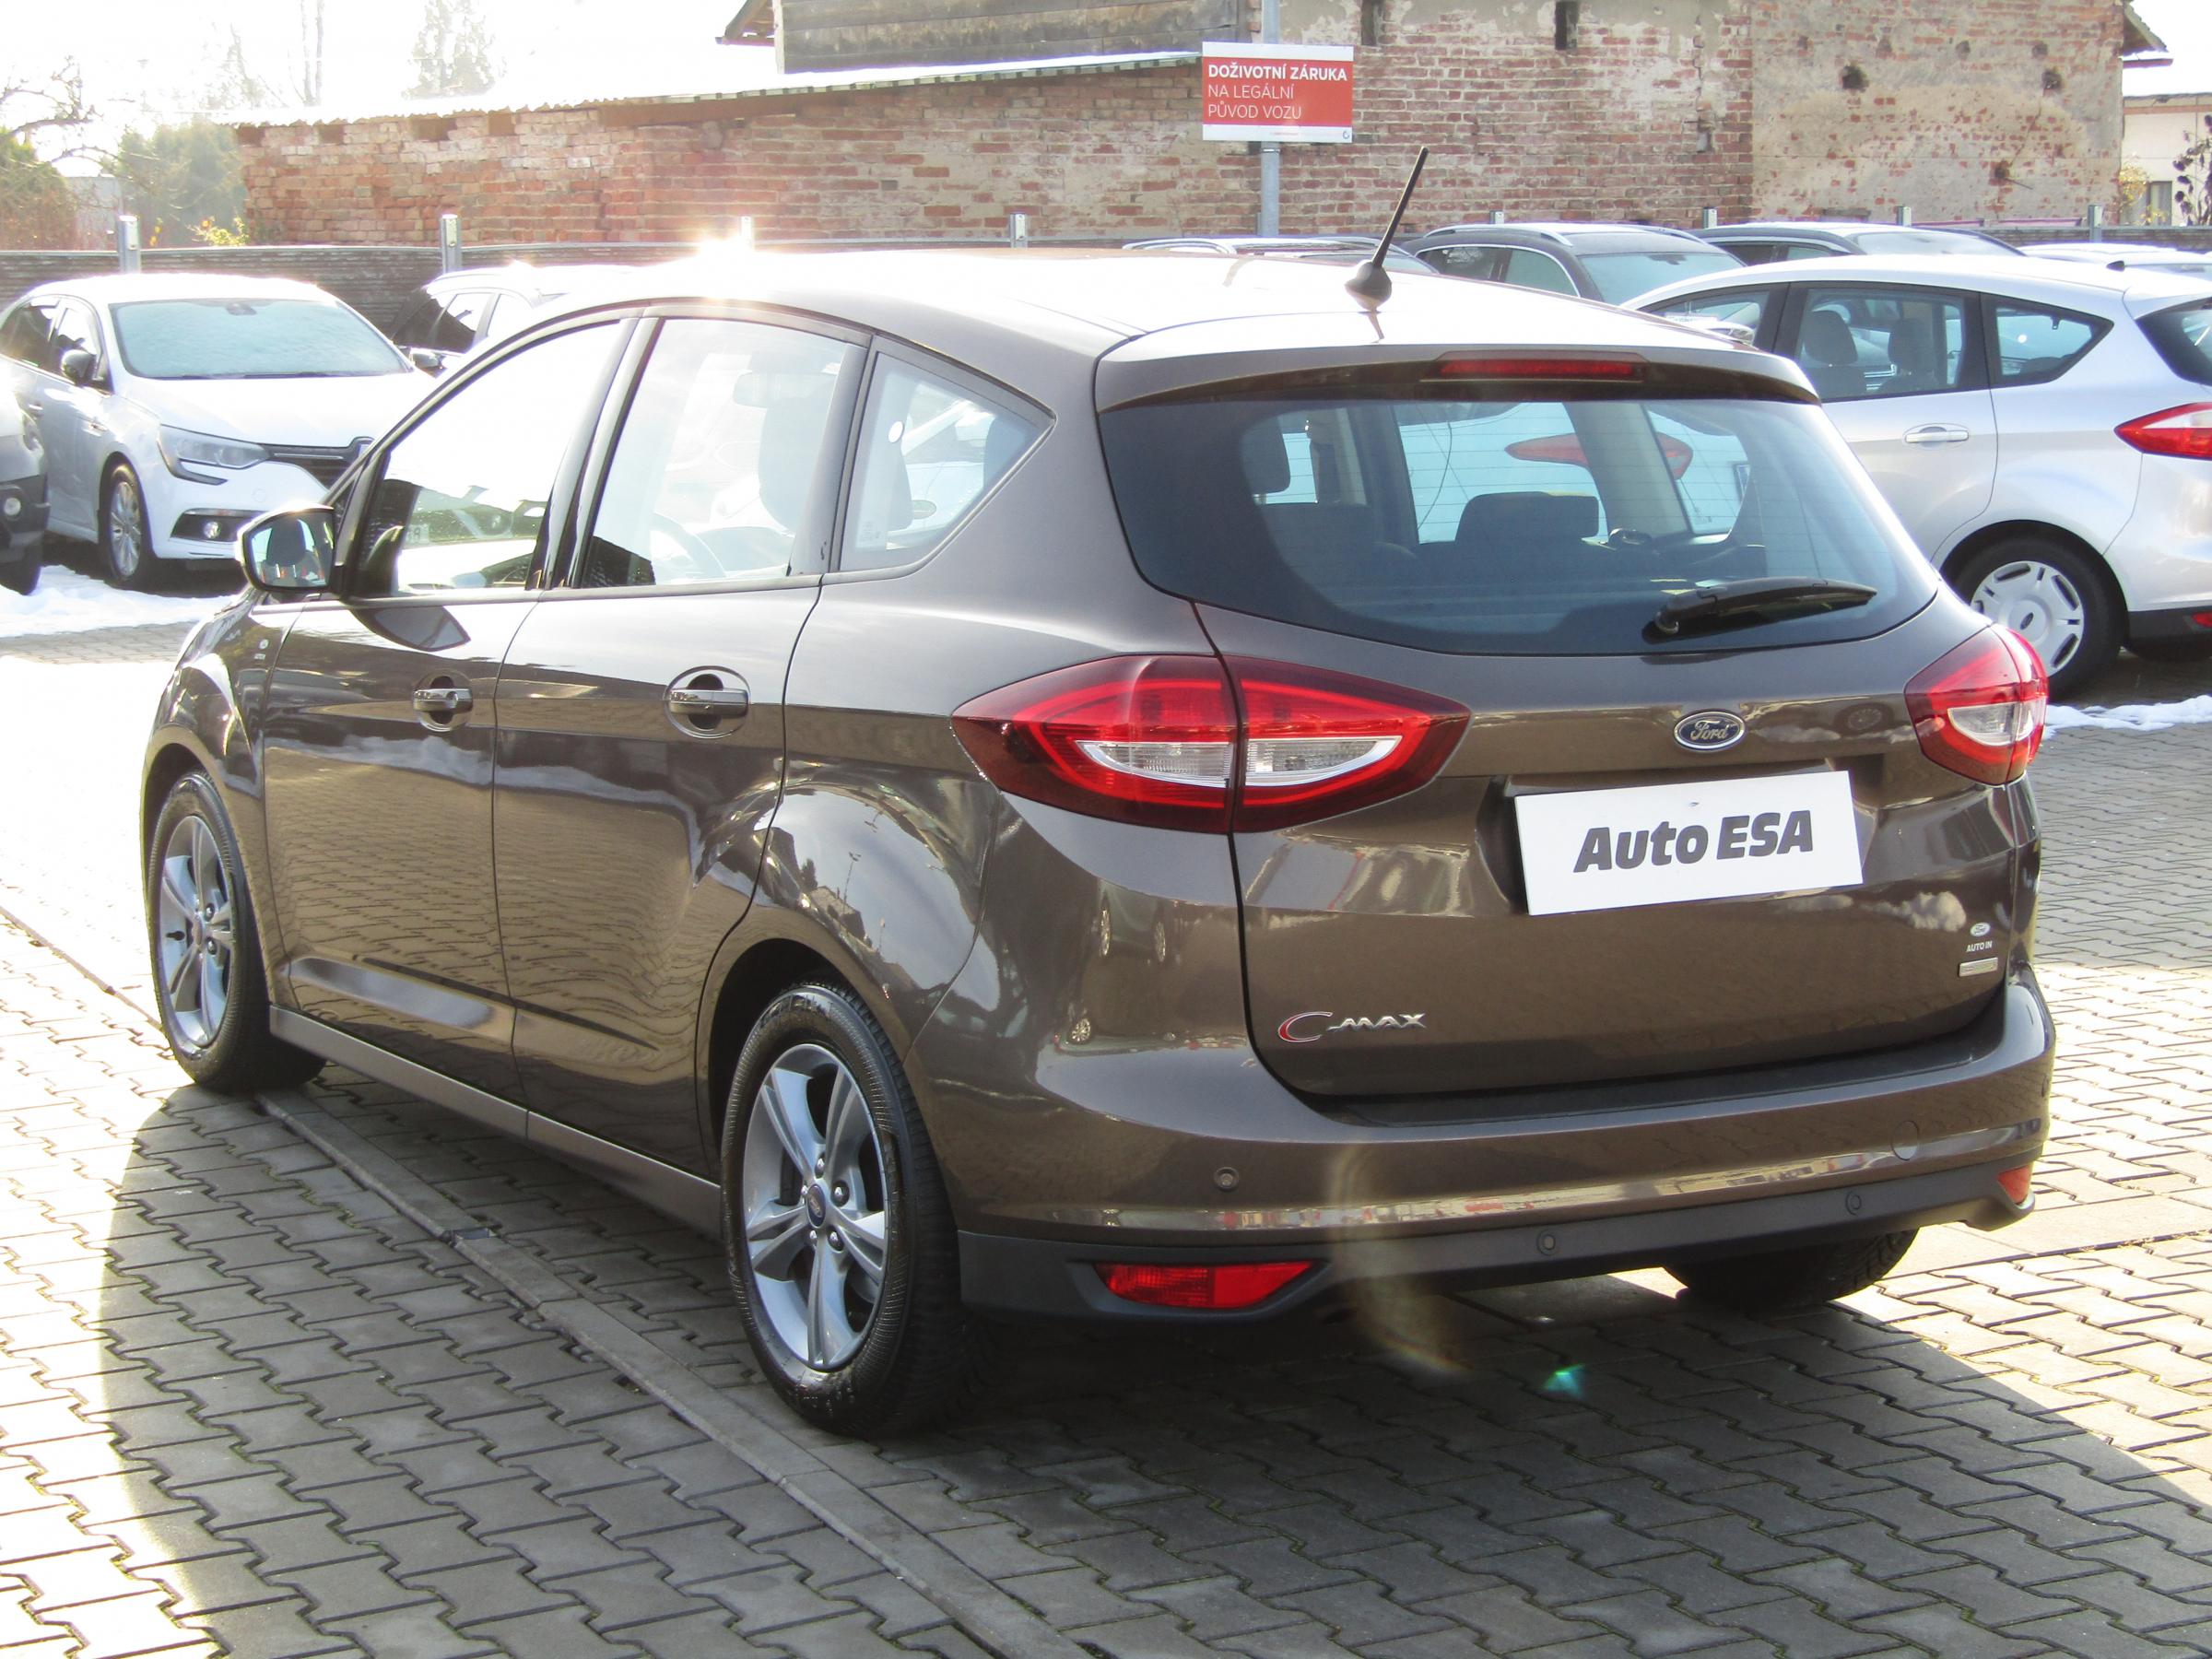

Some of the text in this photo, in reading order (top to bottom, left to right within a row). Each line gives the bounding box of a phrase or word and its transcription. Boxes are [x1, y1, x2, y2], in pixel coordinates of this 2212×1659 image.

[1208, 62, 1347, 81] DOŽIVOTNÍ ZÁRUKA
[1208, 83, 1294, 100] NA LEGÁLNÍ
[1208, 100, 1301, 119] PŮVOD VOZU
[1690, 719, 1730, 741] Ford
[1572, 810, 1813, 873] Auto ESA
[1966, 942, 1984, 952] AUTO
